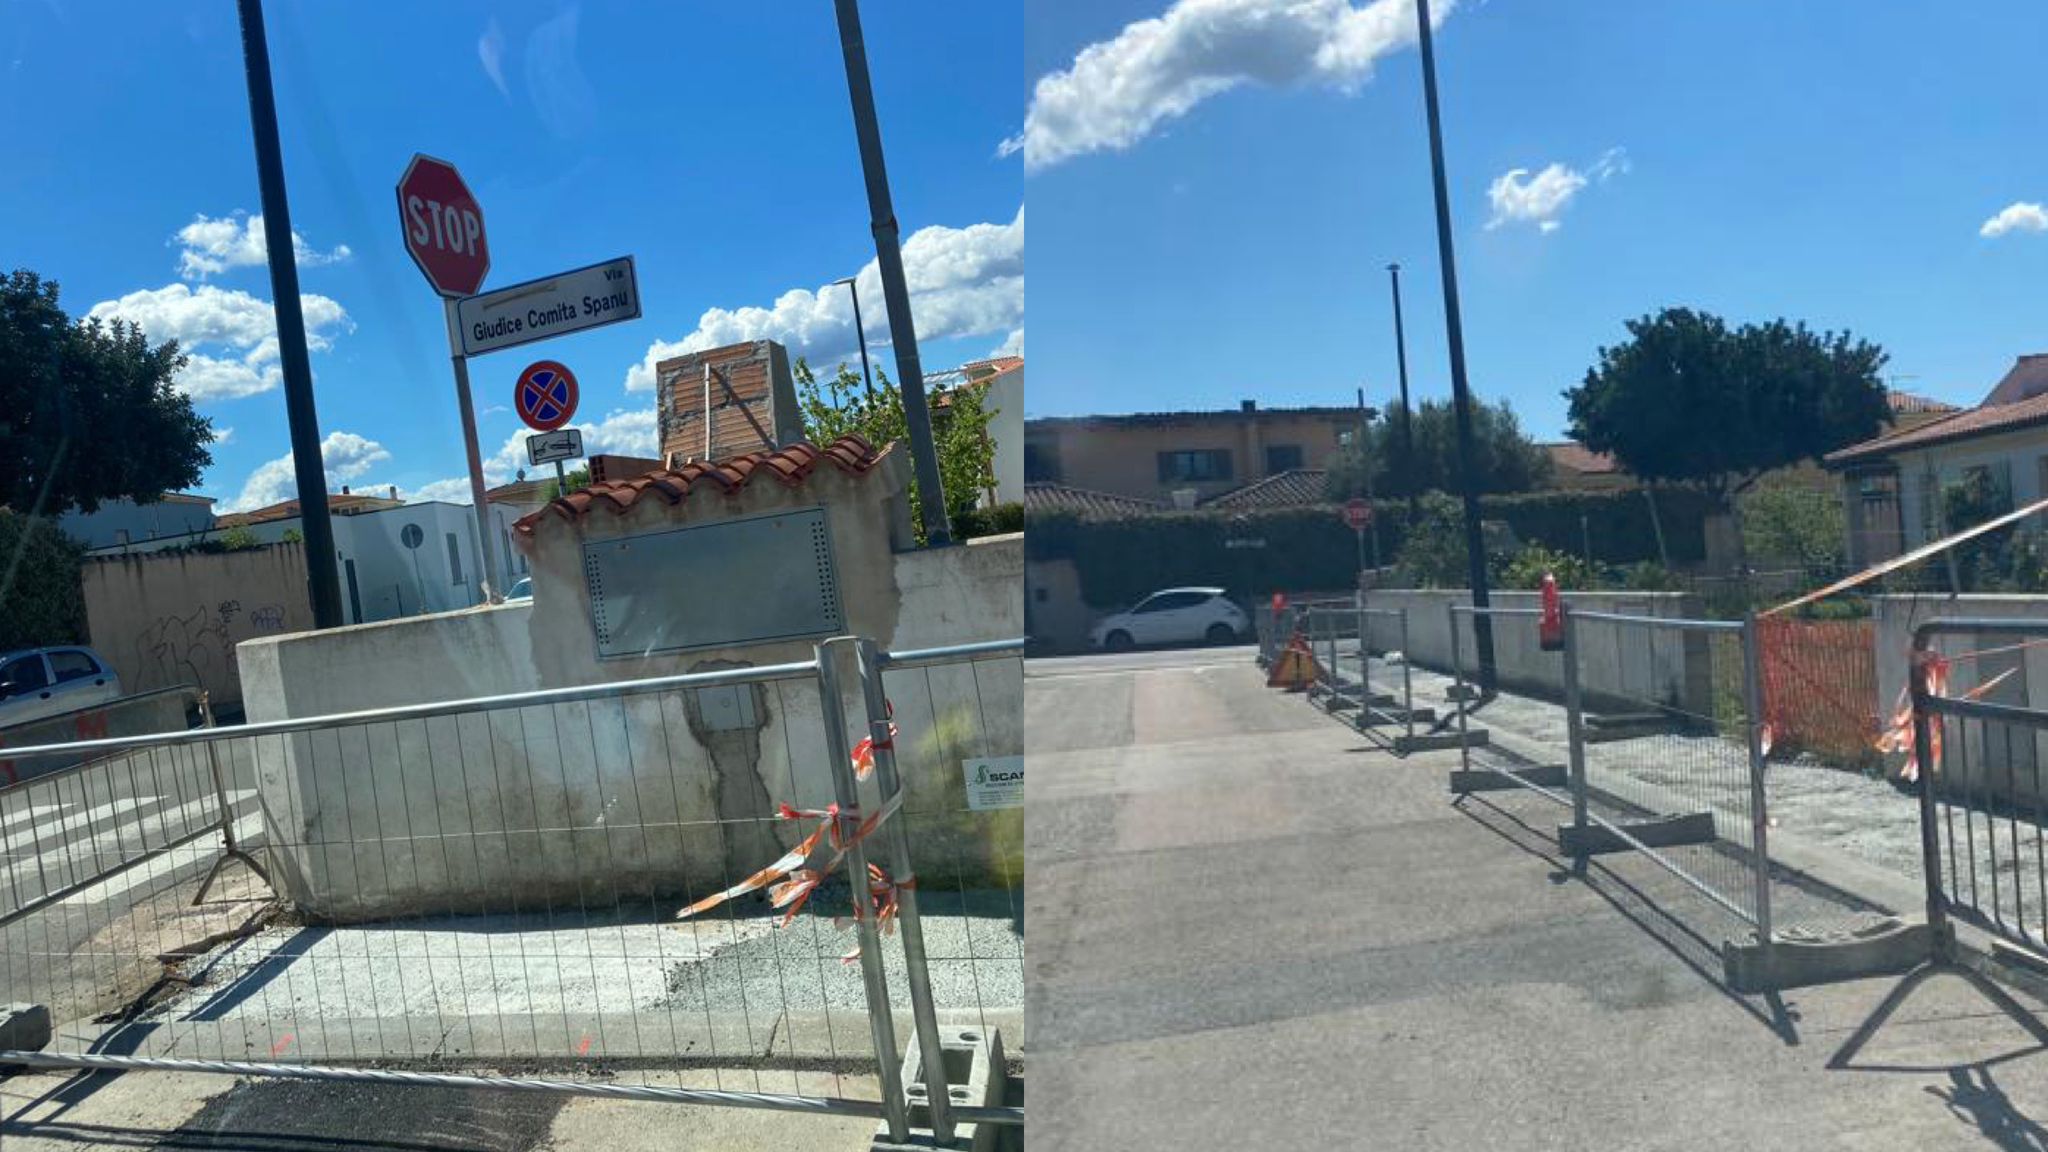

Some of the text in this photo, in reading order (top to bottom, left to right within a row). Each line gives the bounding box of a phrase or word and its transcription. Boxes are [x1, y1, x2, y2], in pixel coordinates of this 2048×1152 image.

[408, 195, 480, 256] STOP
[604, 269, 624, 281] Via
[473, 291, 629, 341] Giudice Comita Spanu
